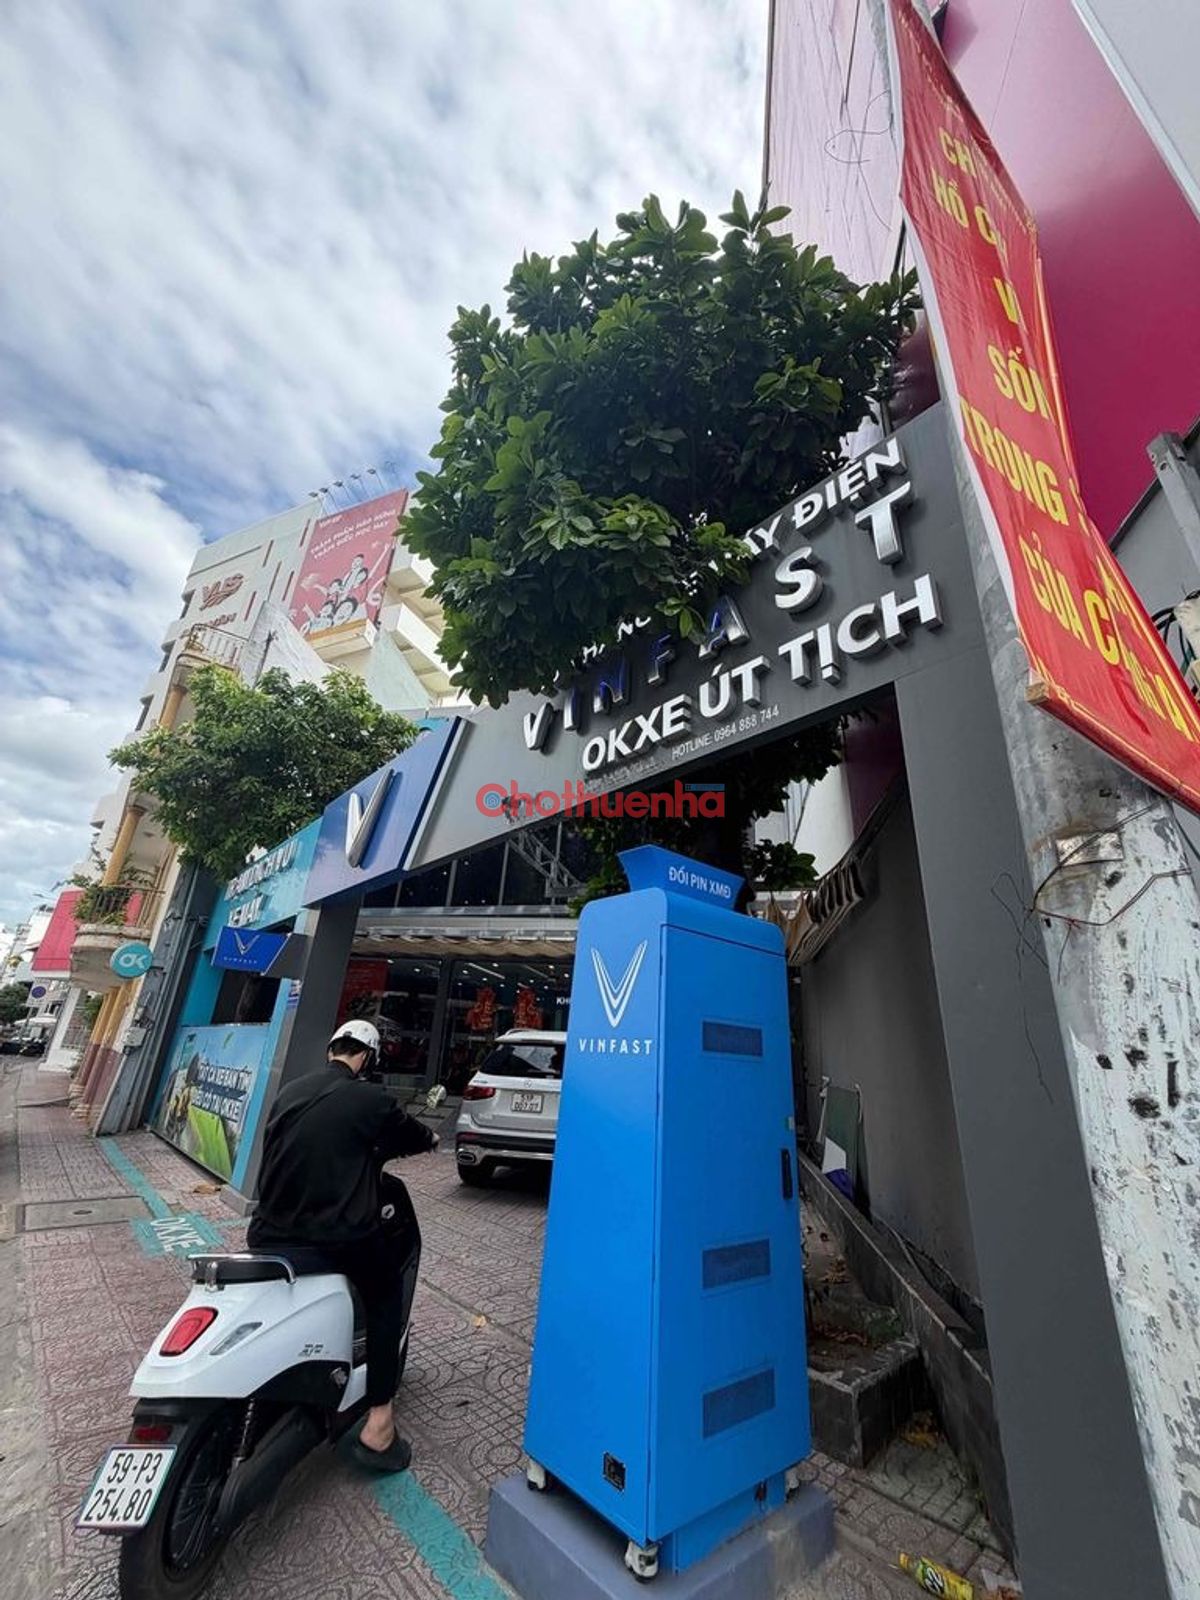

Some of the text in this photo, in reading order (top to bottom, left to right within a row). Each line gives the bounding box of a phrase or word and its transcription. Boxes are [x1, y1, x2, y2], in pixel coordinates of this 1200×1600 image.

[792, 436, 907, 530] ĐIỆN
[582, 574, 939, 772] OKXE ÚT TỊCH
[759, 704, 780, 722] 744
[690, 873, 708, 891] PIN
[579, 1039, 653, 1055] VINFAST
[150, 1217, 206, 1252] OKXE
[107, 1452, 163, 1484] 59-P3
[83, 1487, 153, 1522] 254.80
